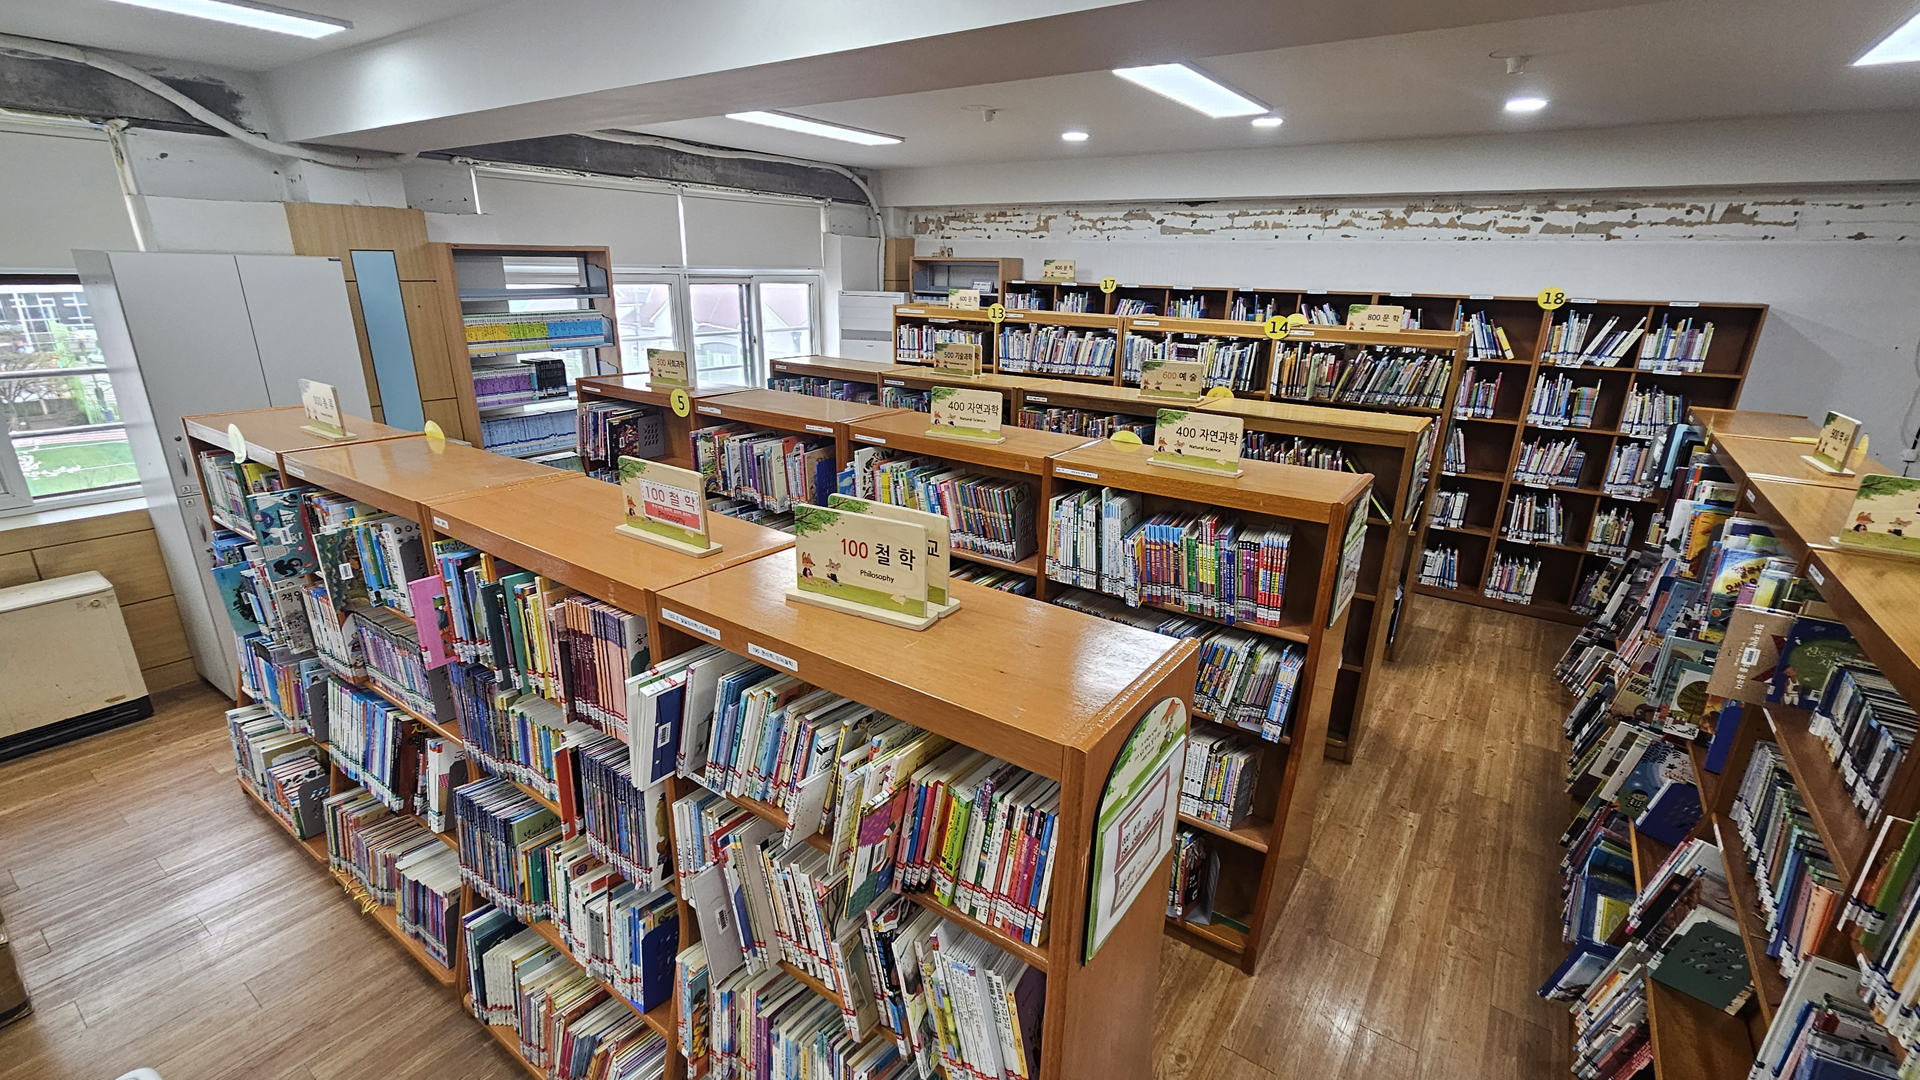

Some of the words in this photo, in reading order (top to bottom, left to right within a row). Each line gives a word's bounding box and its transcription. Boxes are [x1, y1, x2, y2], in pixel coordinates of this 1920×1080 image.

[1103, 280, 1115, 289] 17
[1543, 292, 1564, 304] 18
[992, 308, 1004, 318] 13
[1270, 321, 1288, 334] 14
[657, 358, 666, 367] 300
[1163, 372, 1177, 380] 600
[678, 395, 685, 410] 5
[947, 401, 965, 411] 400
[967, 402, 999, 416] 자연과학
[1176, 426, 1196, 438] 400
[1199, 428, 1239, 446] 자연과학
[645, 486, 665, 503] 100
[841, 538, 868, 559] 100
[860, 569, 895, 583] Philosophy
